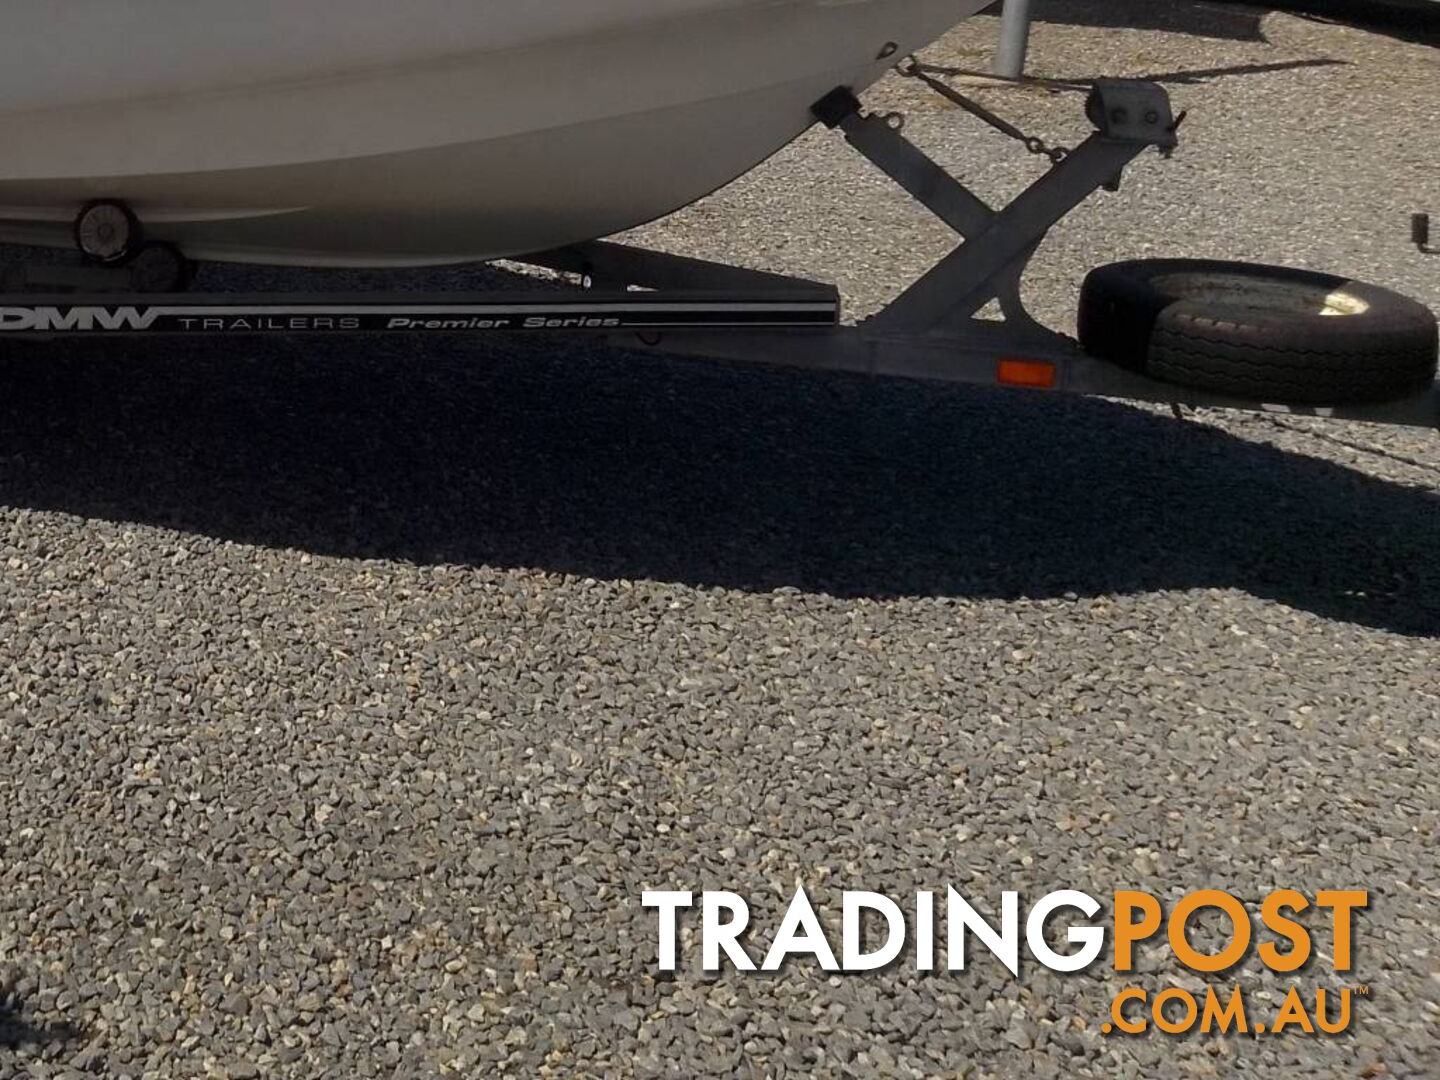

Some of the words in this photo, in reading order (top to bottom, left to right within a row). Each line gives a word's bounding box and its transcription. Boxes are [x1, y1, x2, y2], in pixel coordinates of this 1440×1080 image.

[179, 317, 361, 330] TRAILERS
[386, 317, 510, 330] Premier
[521, 316, 621, 329] Series
